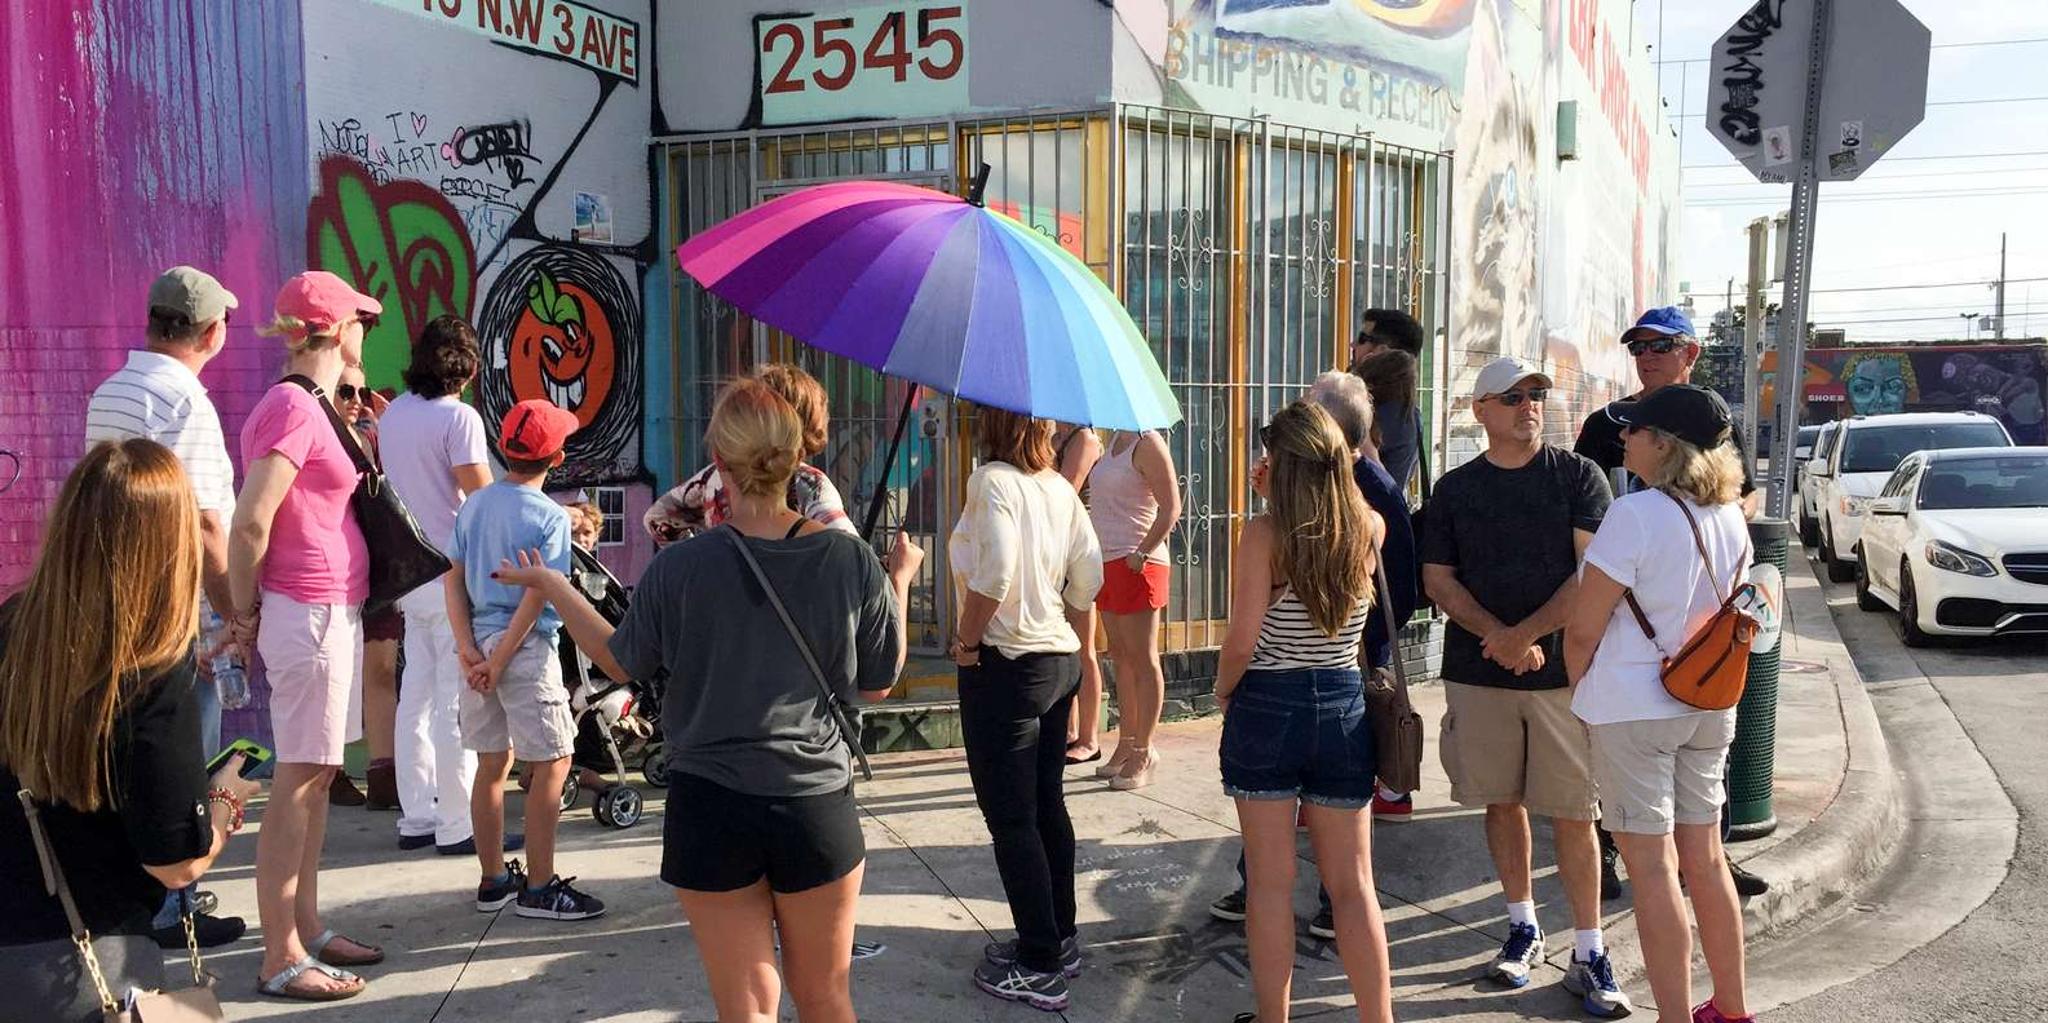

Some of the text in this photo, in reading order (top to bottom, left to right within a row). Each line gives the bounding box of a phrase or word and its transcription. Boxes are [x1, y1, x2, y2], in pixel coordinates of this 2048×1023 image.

[553, 4, 576, 55] 3
[580, 15, 635, 76] AVE
[762, 6, 964, 94] 2545
[1338, 66, 1361, 113] &
[385, 111, 406, 144] I
